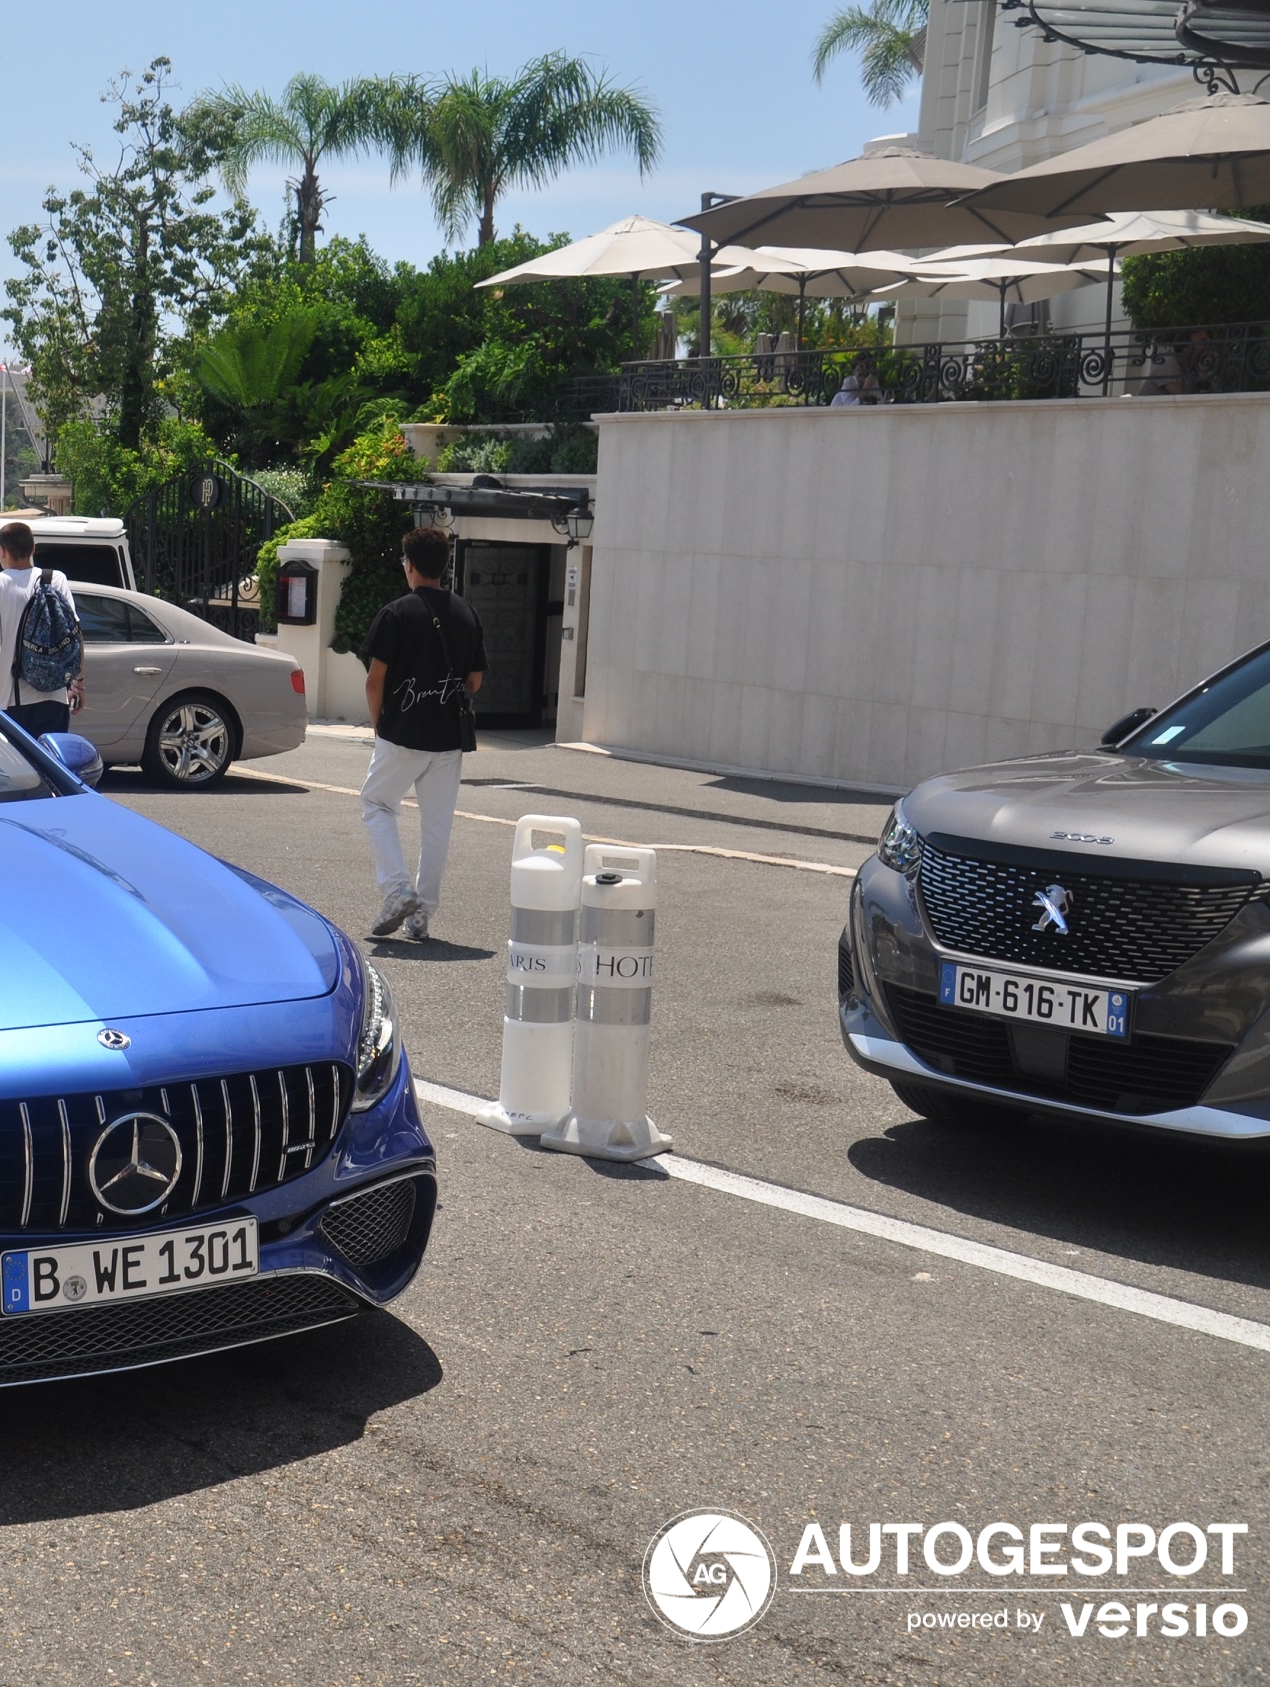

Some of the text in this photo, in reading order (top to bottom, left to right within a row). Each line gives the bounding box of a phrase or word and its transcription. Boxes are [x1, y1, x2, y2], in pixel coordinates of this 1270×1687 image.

[944, 987, 951, 998] F
[959, 971, 1101, 1029] GM-616-TK
[1108, 1014, 1125, 1034] 01
[33, 1227, 253, 1303] B WE 1301
[11, 1288, 22, 1302] D
